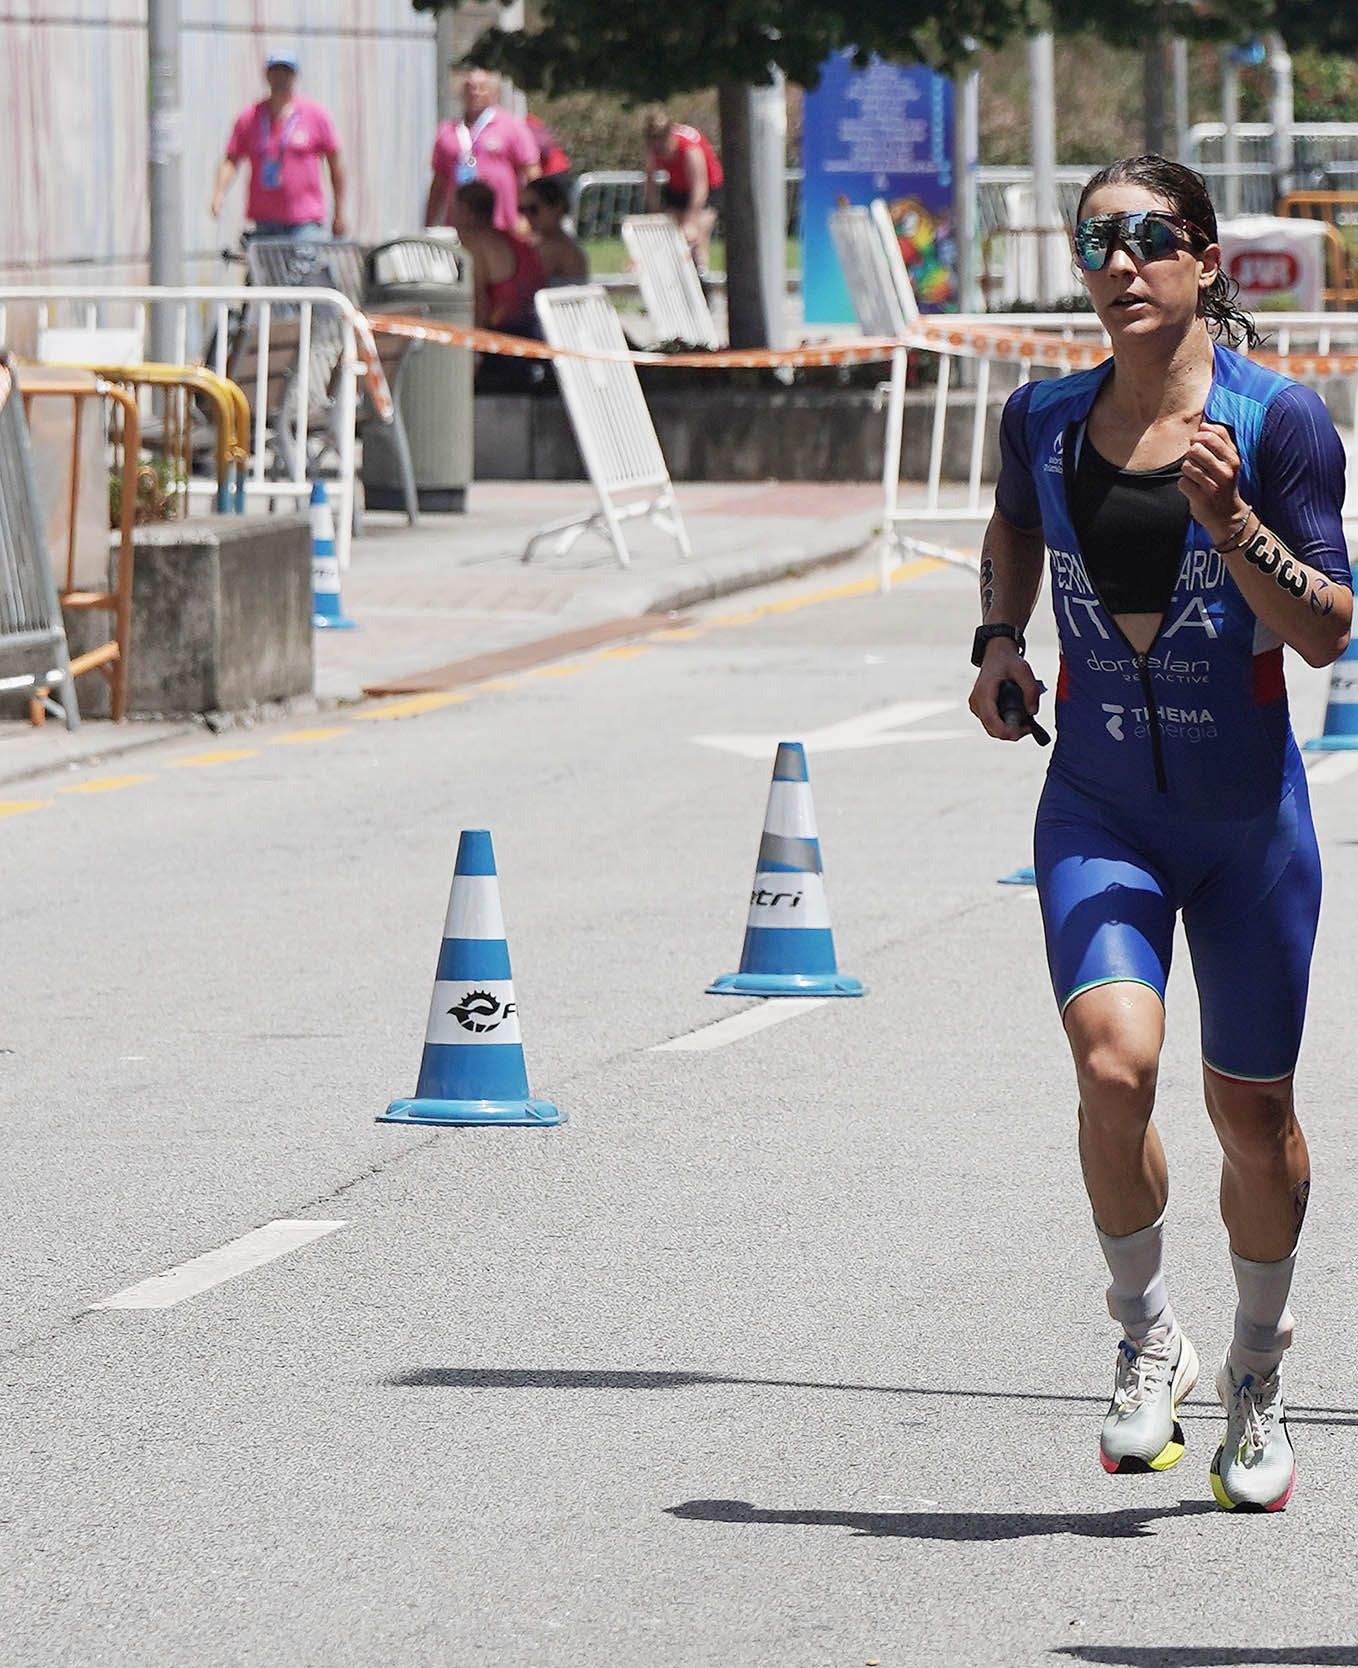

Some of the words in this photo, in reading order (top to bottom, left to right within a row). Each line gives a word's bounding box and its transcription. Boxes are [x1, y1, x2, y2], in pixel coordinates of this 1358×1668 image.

[1086, 650, 1210, 673] dorelan
[1130, 705, 1215, 724] THEMA
[1133, 723, 1218, 743] energia
